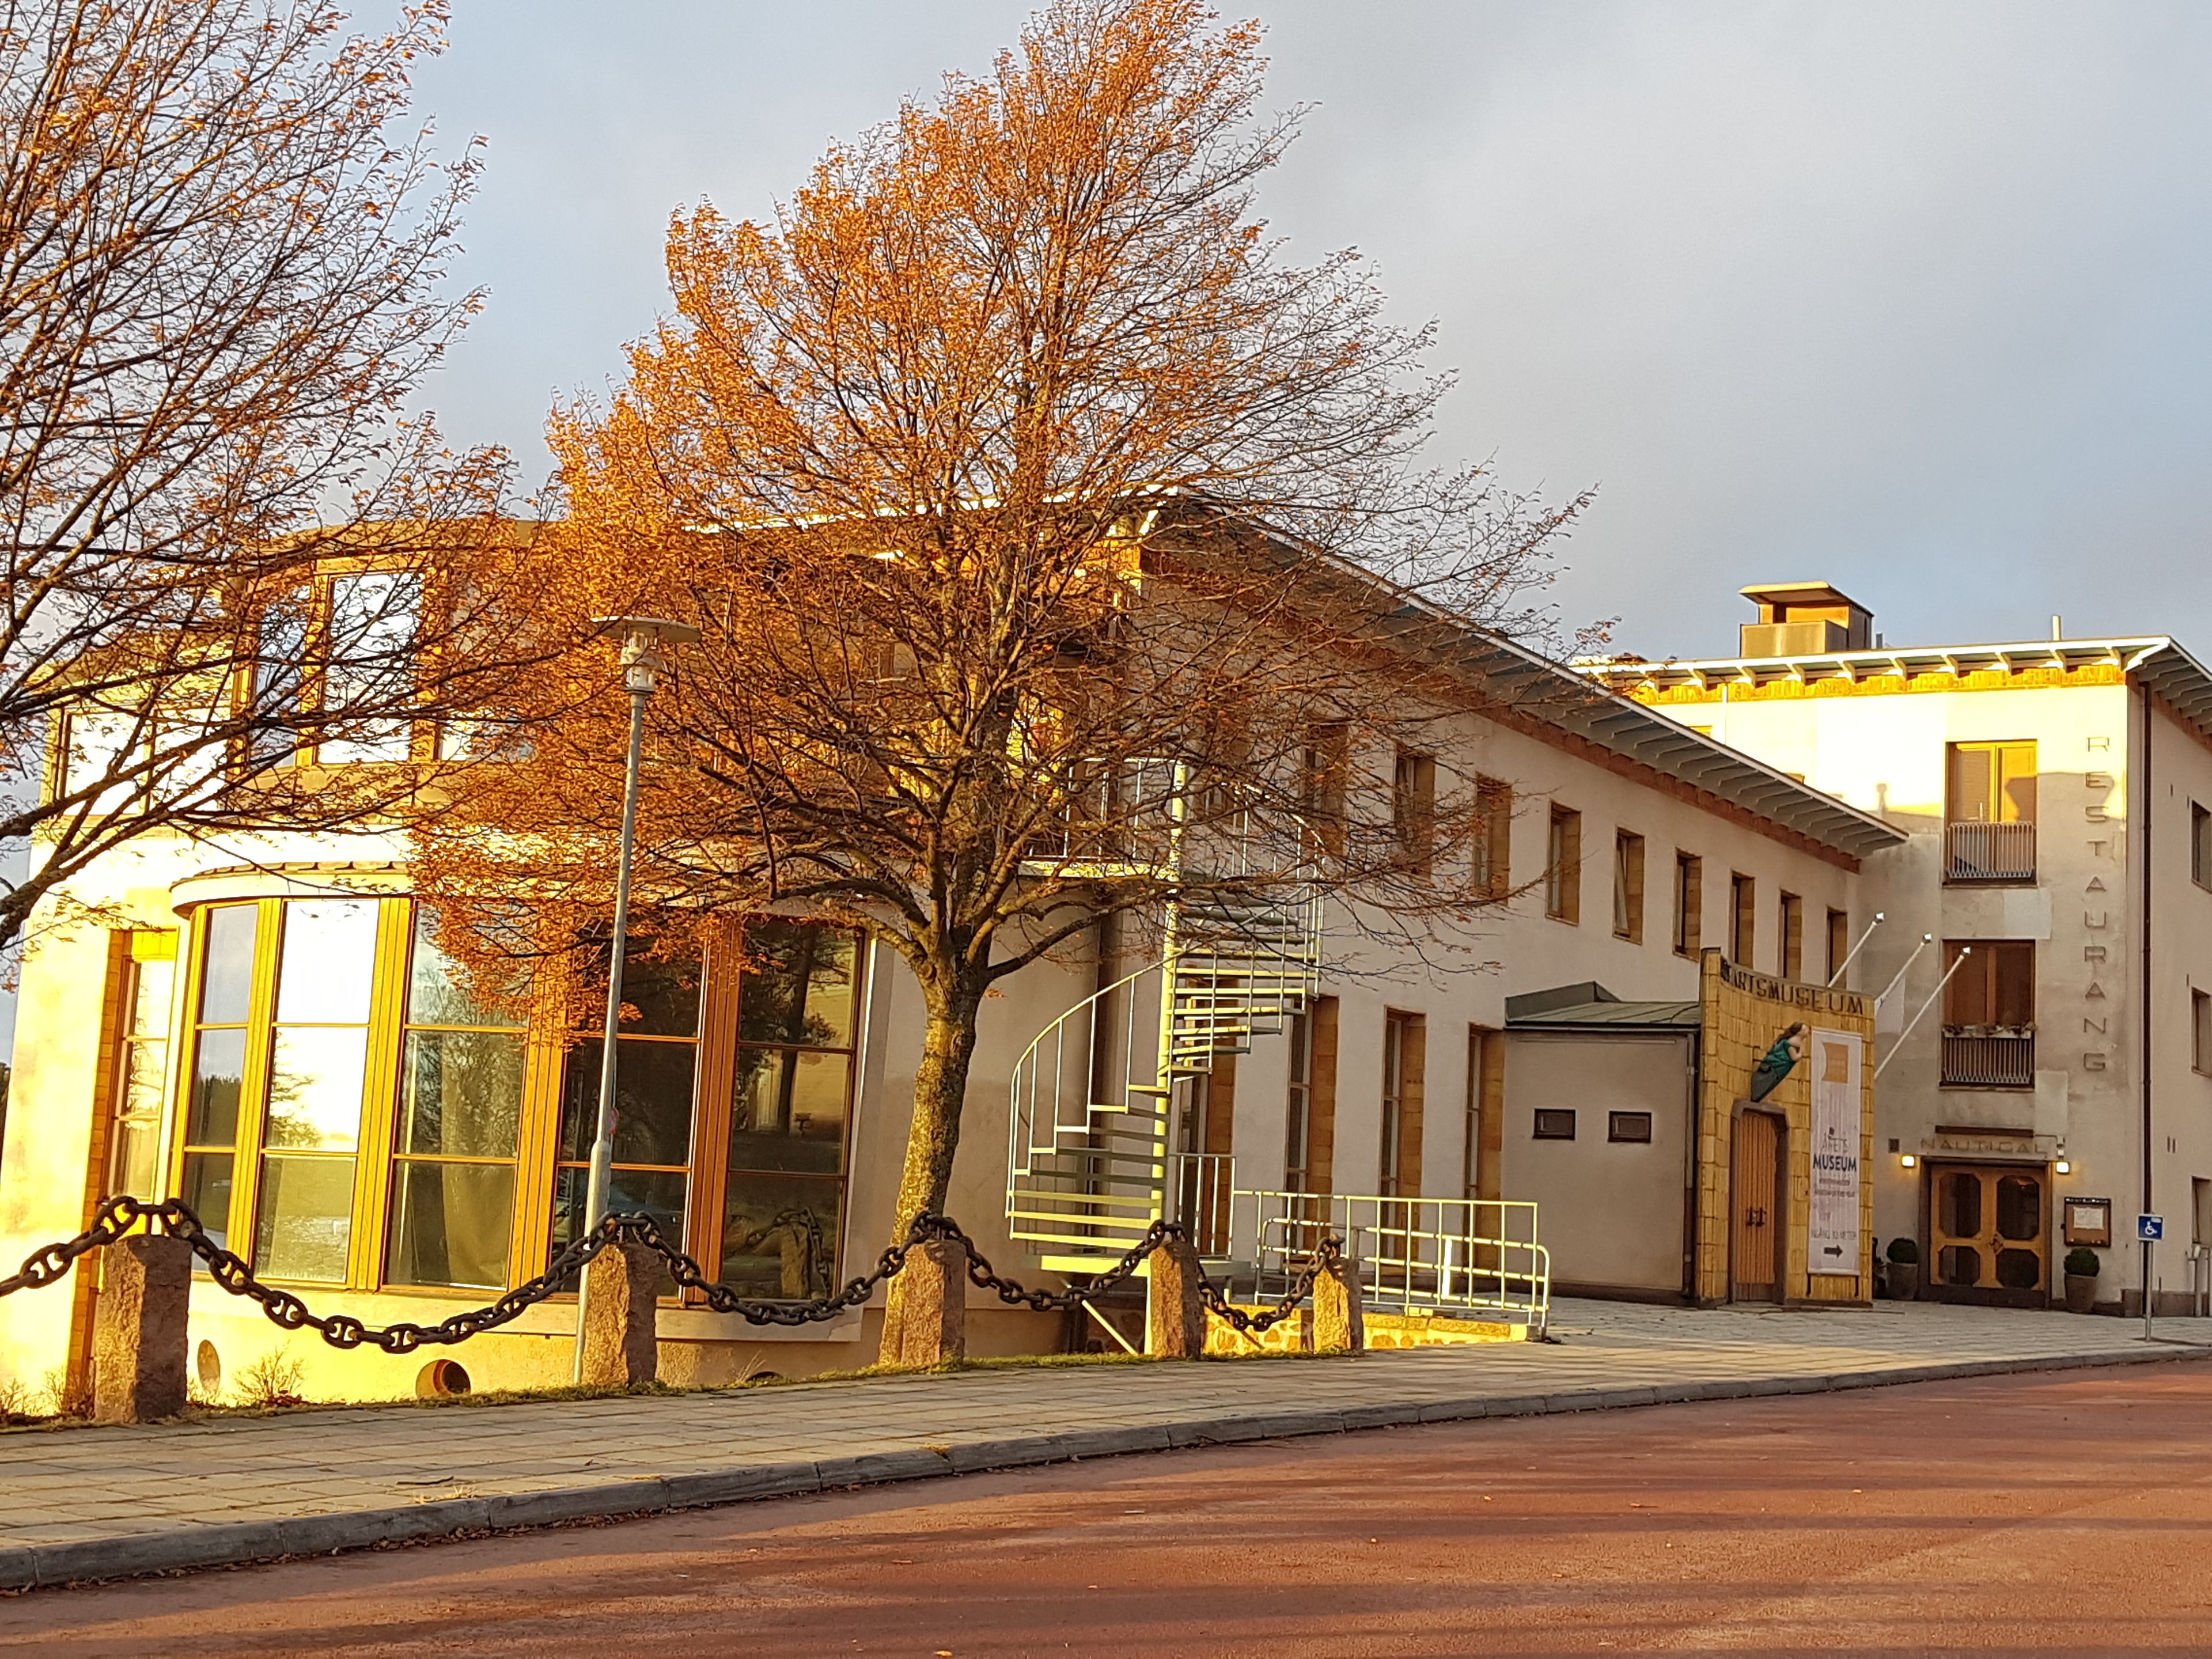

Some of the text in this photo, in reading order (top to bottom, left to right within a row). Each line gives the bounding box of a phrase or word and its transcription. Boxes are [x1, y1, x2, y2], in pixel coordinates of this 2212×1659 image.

[2084, 737, 2109, 1071] RESTAURANG
[1921, 1138, 2047, 1154] NAUTICAL
[1813, 1153, 1857, 1172] MUSEUM
